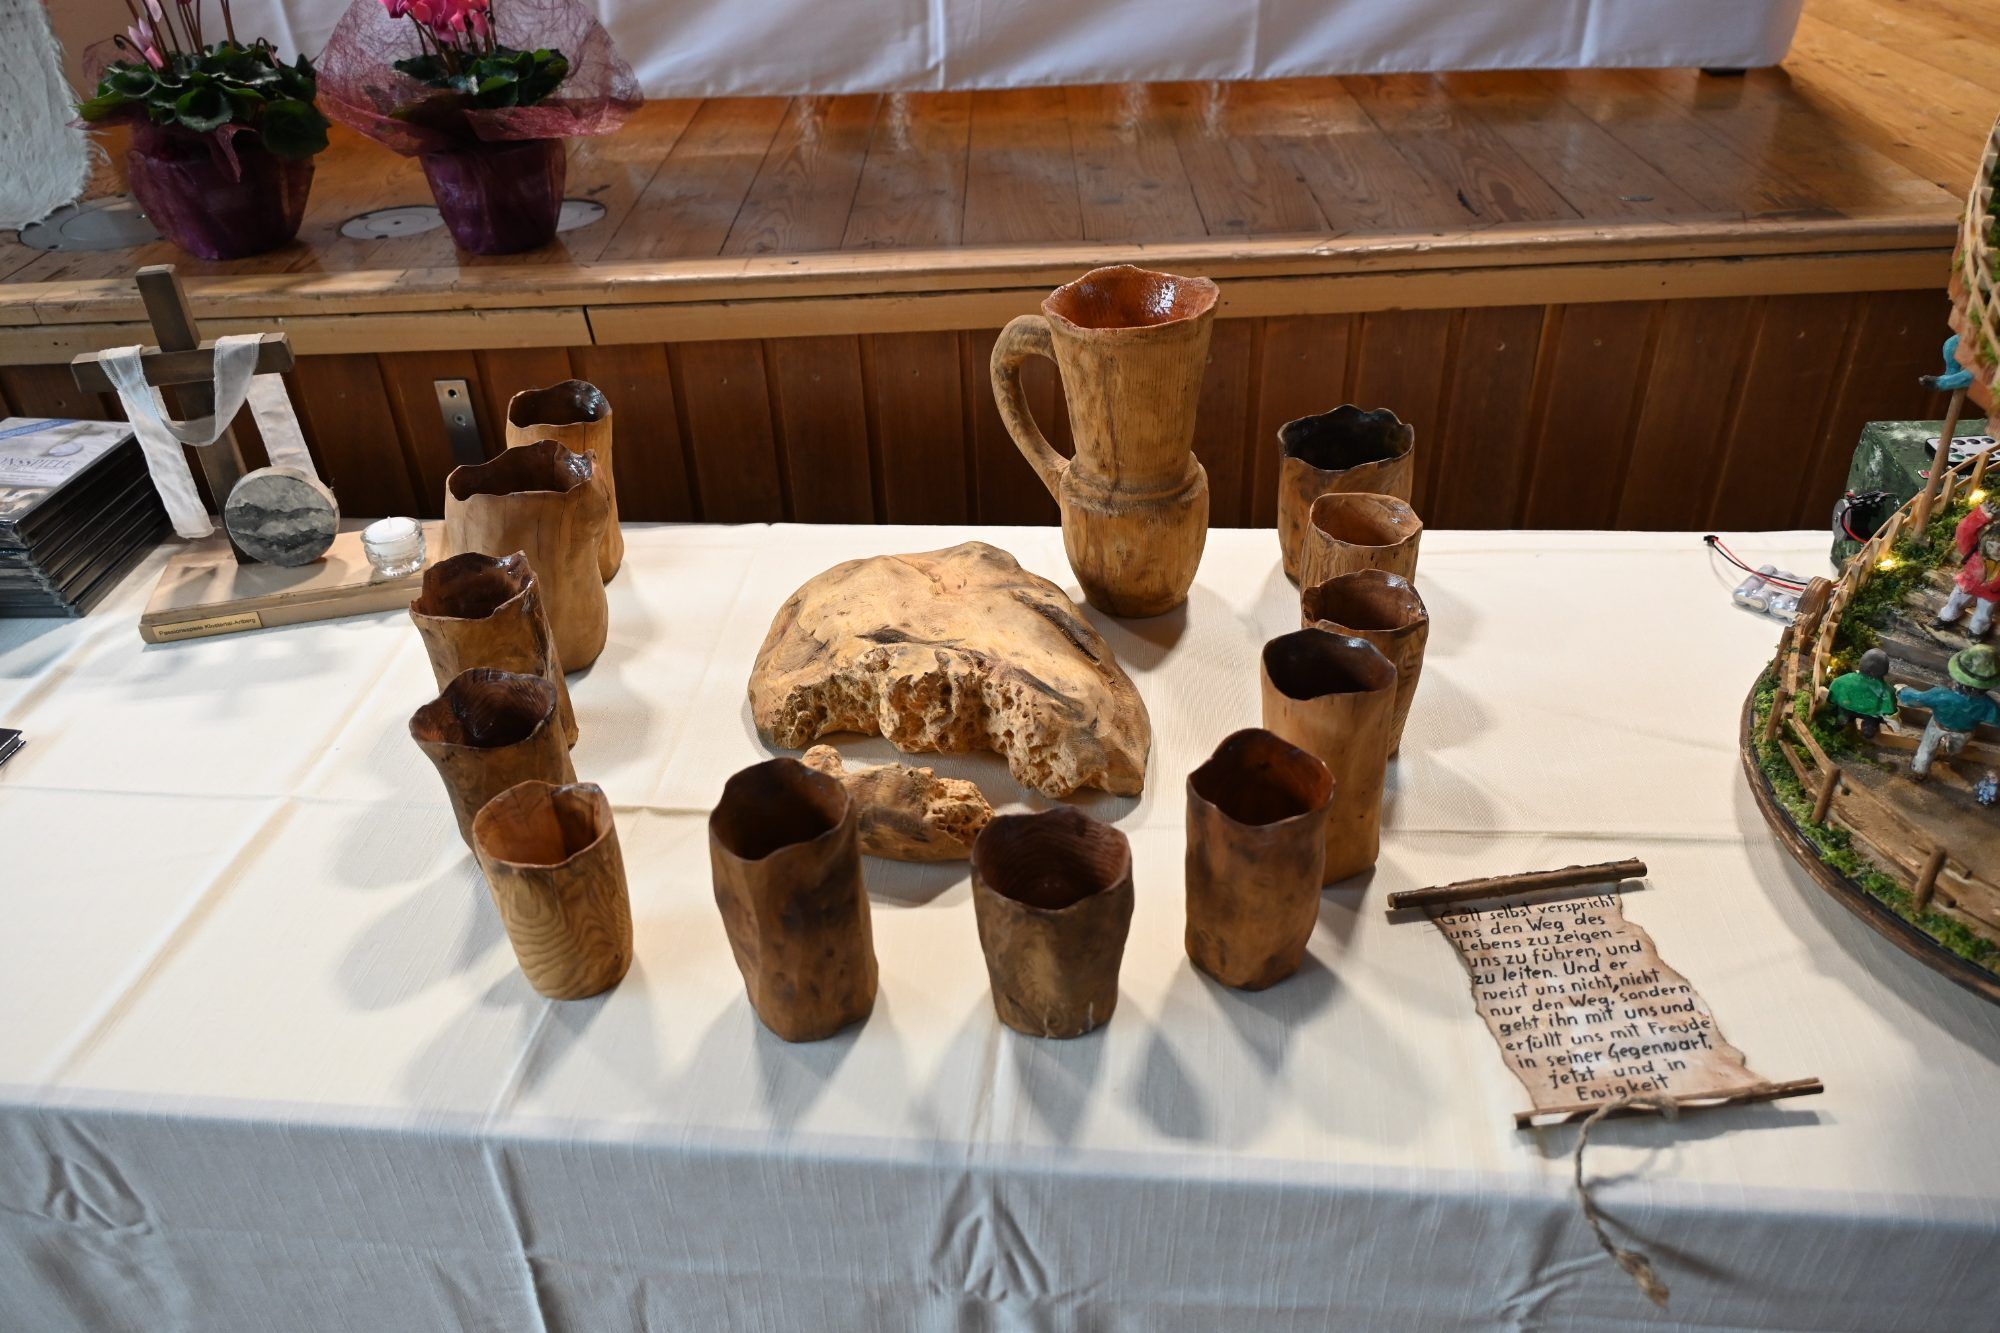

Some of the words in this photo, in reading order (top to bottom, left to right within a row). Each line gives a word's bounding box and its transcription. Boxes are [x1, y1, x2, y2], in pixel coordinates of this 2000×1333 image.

[1440, 906, 1482, 925] Gott
[1490, 901, 1533, 920] selbst
[1537, 893, 1616, 915] verspricht
[1449, 928, 1482, 939] uns
[1490, 921, 1523, 935] den
[1525, 916, 1565, 932] Weg
[1574, 912, 1606, 926] des
[1459, 938, 1522, 952] Lebens
[1526, 935, 1549, 946] zu
[1553, 929, 1613, 944] zeigen
[1468, 956, 1502, 968] uns
[1504, 953, 1527, 965] zu
[1532, 945, 1601, 965] führen,
[1605, 939, 1643, 956] und
[1473, 973, 1496, 985] zu
[1502, 964, 1559, 982] leiten.
[1562, 957, 1601, 976] Und
[1608, 960, 1629, 971] er
[1490, 1004, 1523, 1017] nur
[1532, 998, 1565, 1012] den
[1619, 985, 1691, 1003] sondern
[1535, 983, 1566, 996] uns
[1499, 1015, 1541, 1037] geht
[1548, 1011, 1579, 1028] ihn
[1585, 1005, 1615, 1025] mit
[1624, 1004, 1659, 1020] uns
[1660, 997, 1695, 1015] und
[1505, 1030, 1563, 1054] erfüllt
[1570, 1032, 1604, 1046] uns
[1609, 1022, 1641, 1039] mit
[1647, 1015, 1711, 1035] Freude
[1515, 1054, 1538, 1069] in
[1546, 1049, 1603, 1068] seiner
[1548, 1065, 1596, 1090] jetzt
[1613, 1060, 1655, 1078] und
[1663, 1058, 1687, 1072] in
[1575, 1073, 1669, 1101] Ewigkeit
